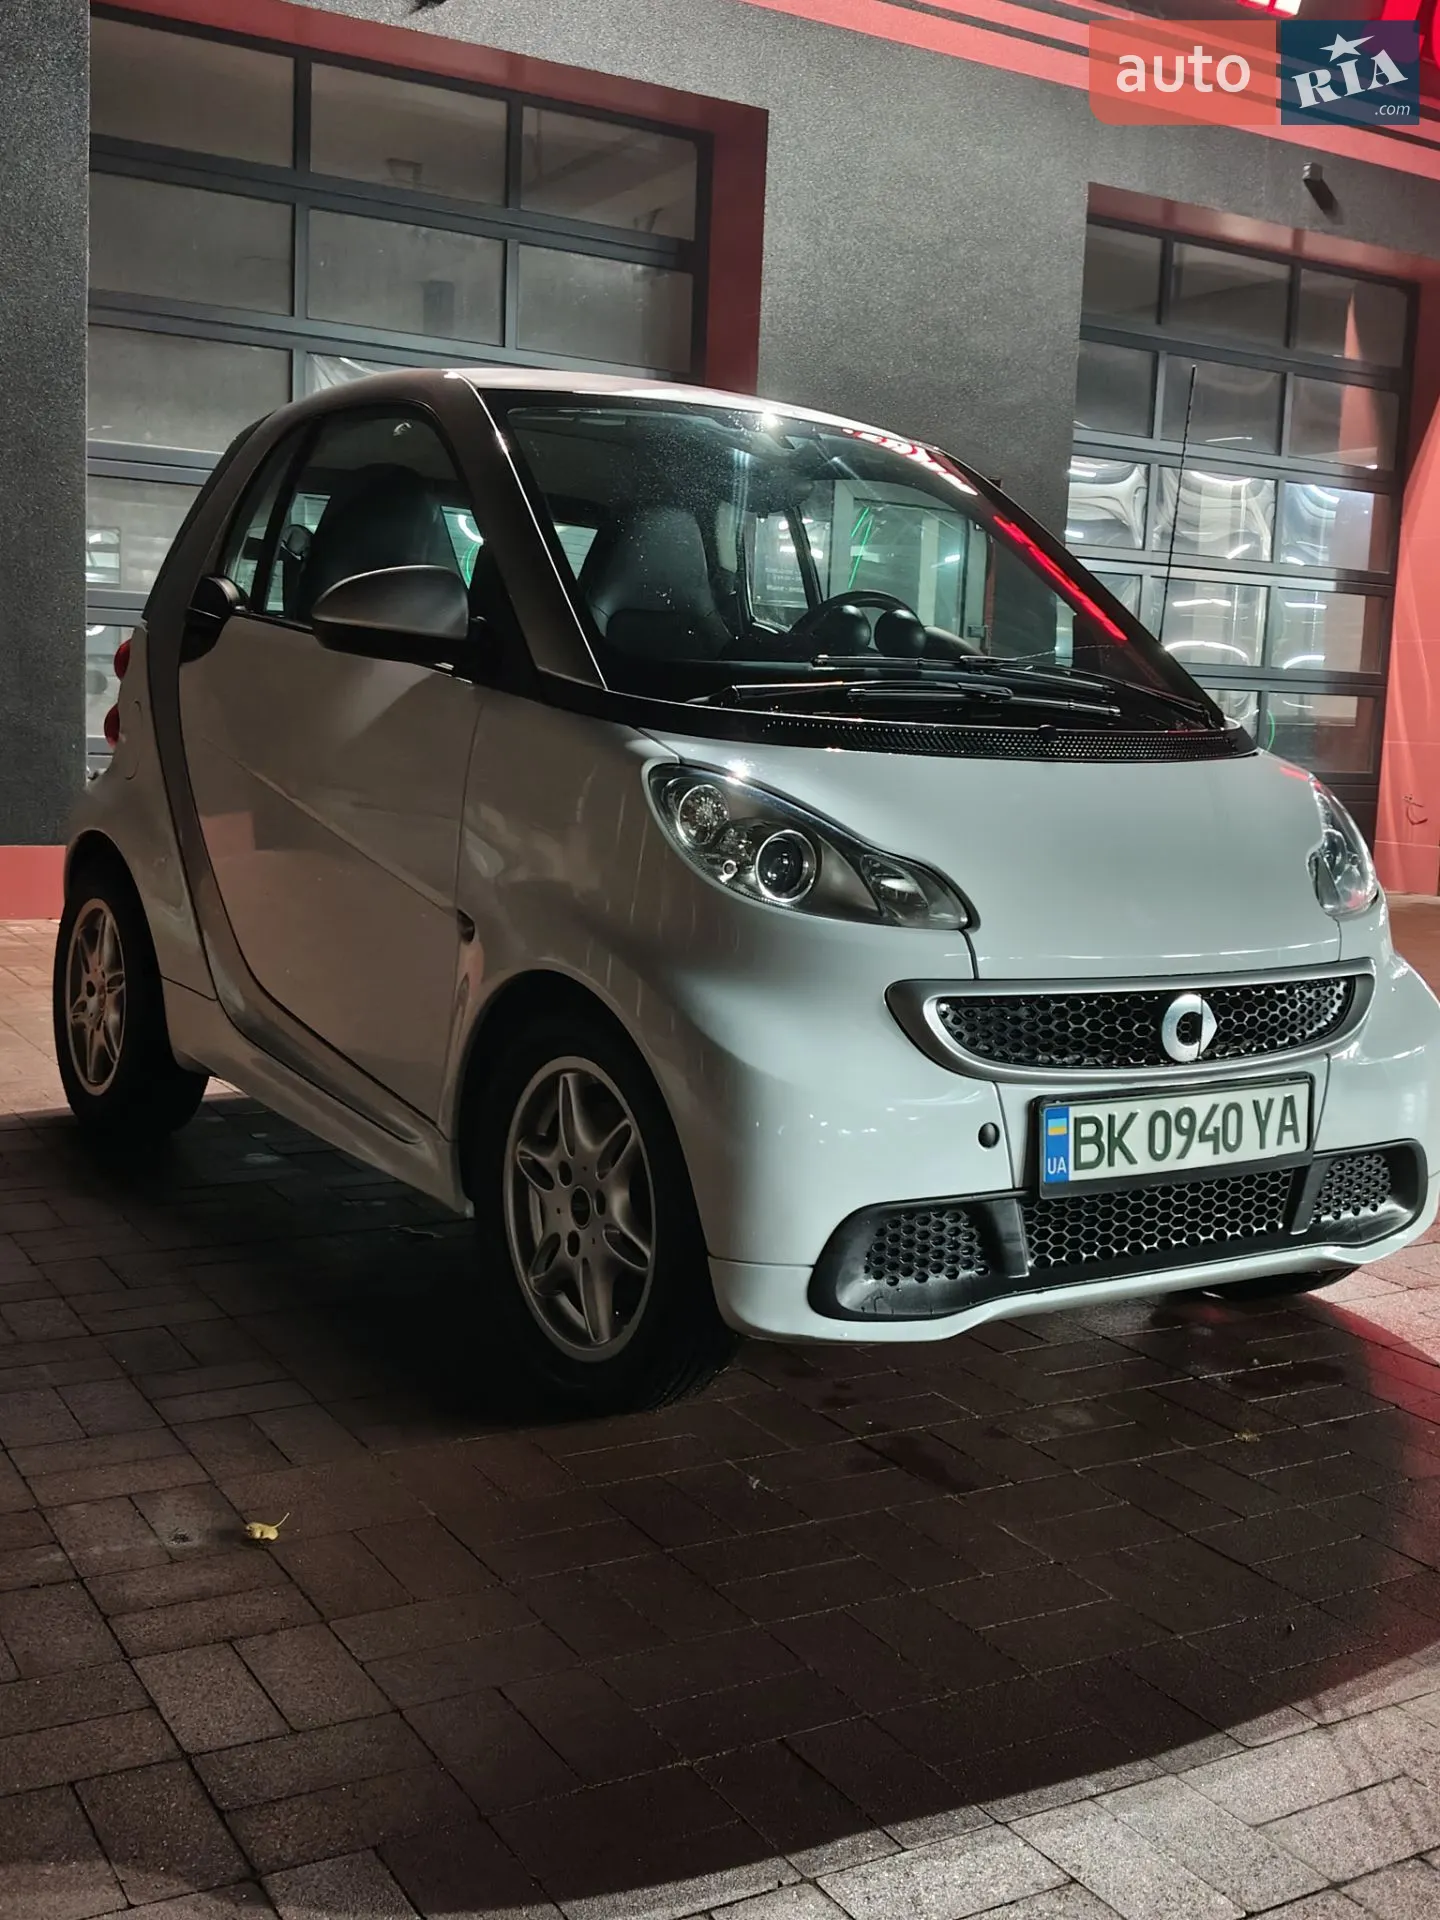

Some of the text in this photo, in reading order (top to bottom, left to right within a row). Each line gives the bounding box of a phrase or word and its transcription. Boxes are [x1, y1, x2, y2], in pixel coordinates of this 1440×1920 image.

[1073, 1094, 1300, 1171] BK 0940 YA
[1047, 1156, 1067, 1175] UA
